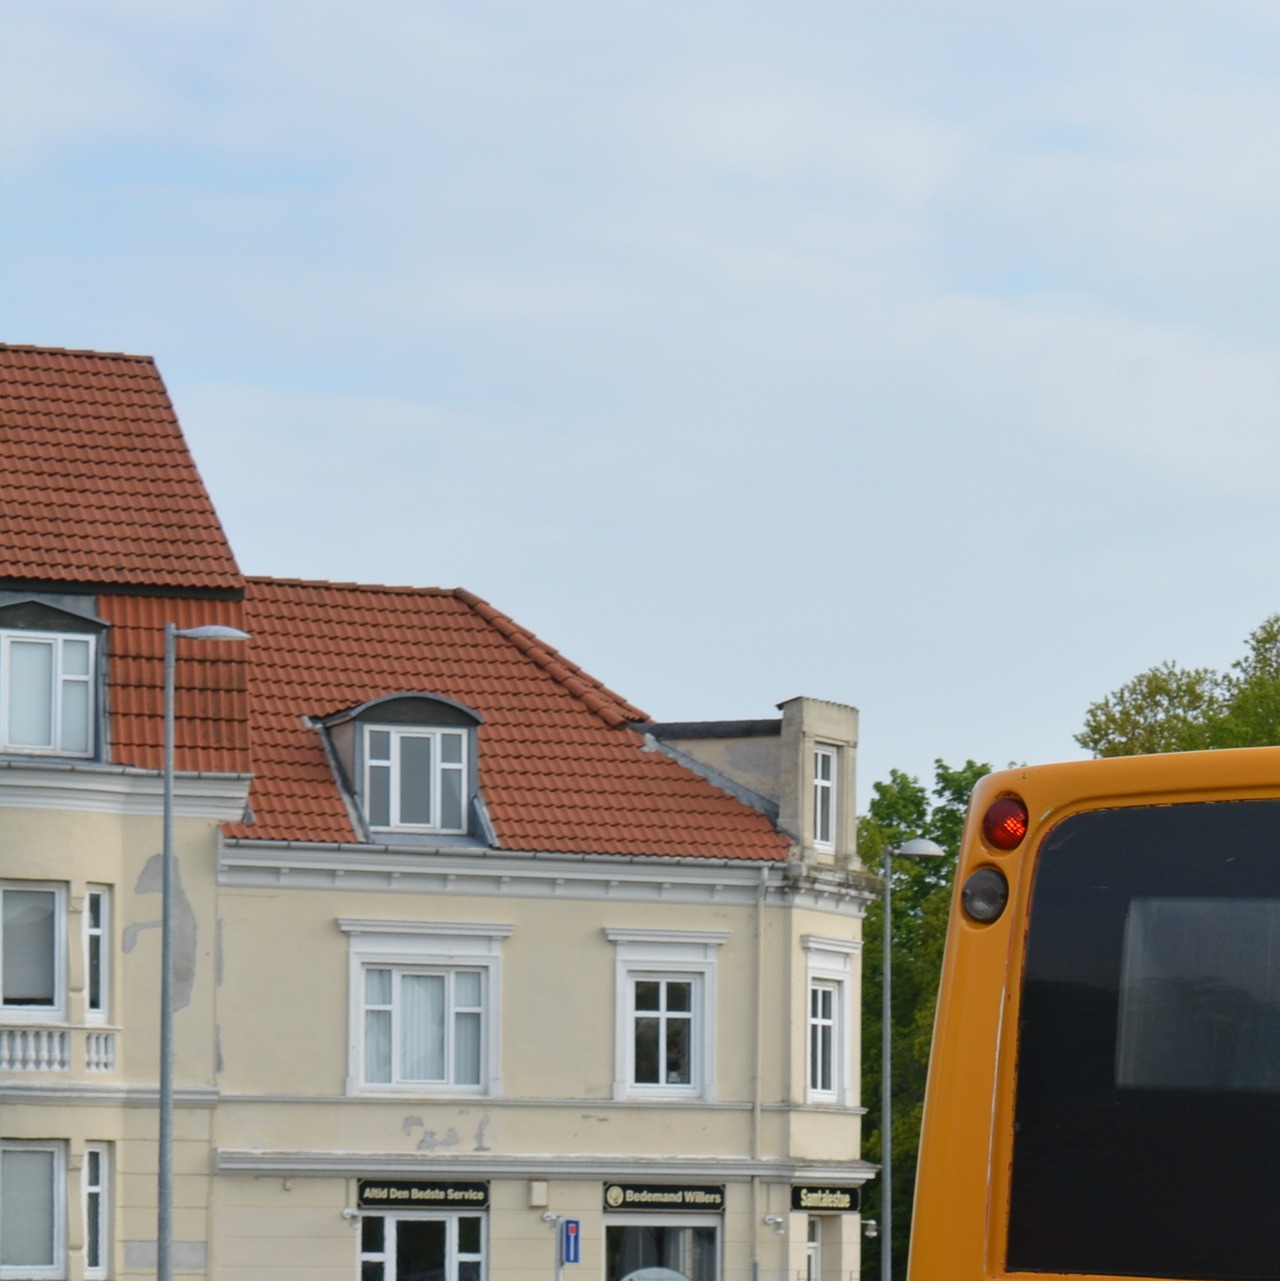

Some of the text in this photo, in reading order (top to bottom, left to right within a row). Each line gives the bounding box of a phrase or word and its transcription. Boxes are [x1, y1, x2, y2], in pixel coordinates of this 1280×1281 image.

[363, 1188, 484, 1200] Altid Den Bedste Service
[625, 1190, 721, 1203] Bedemand Willers
